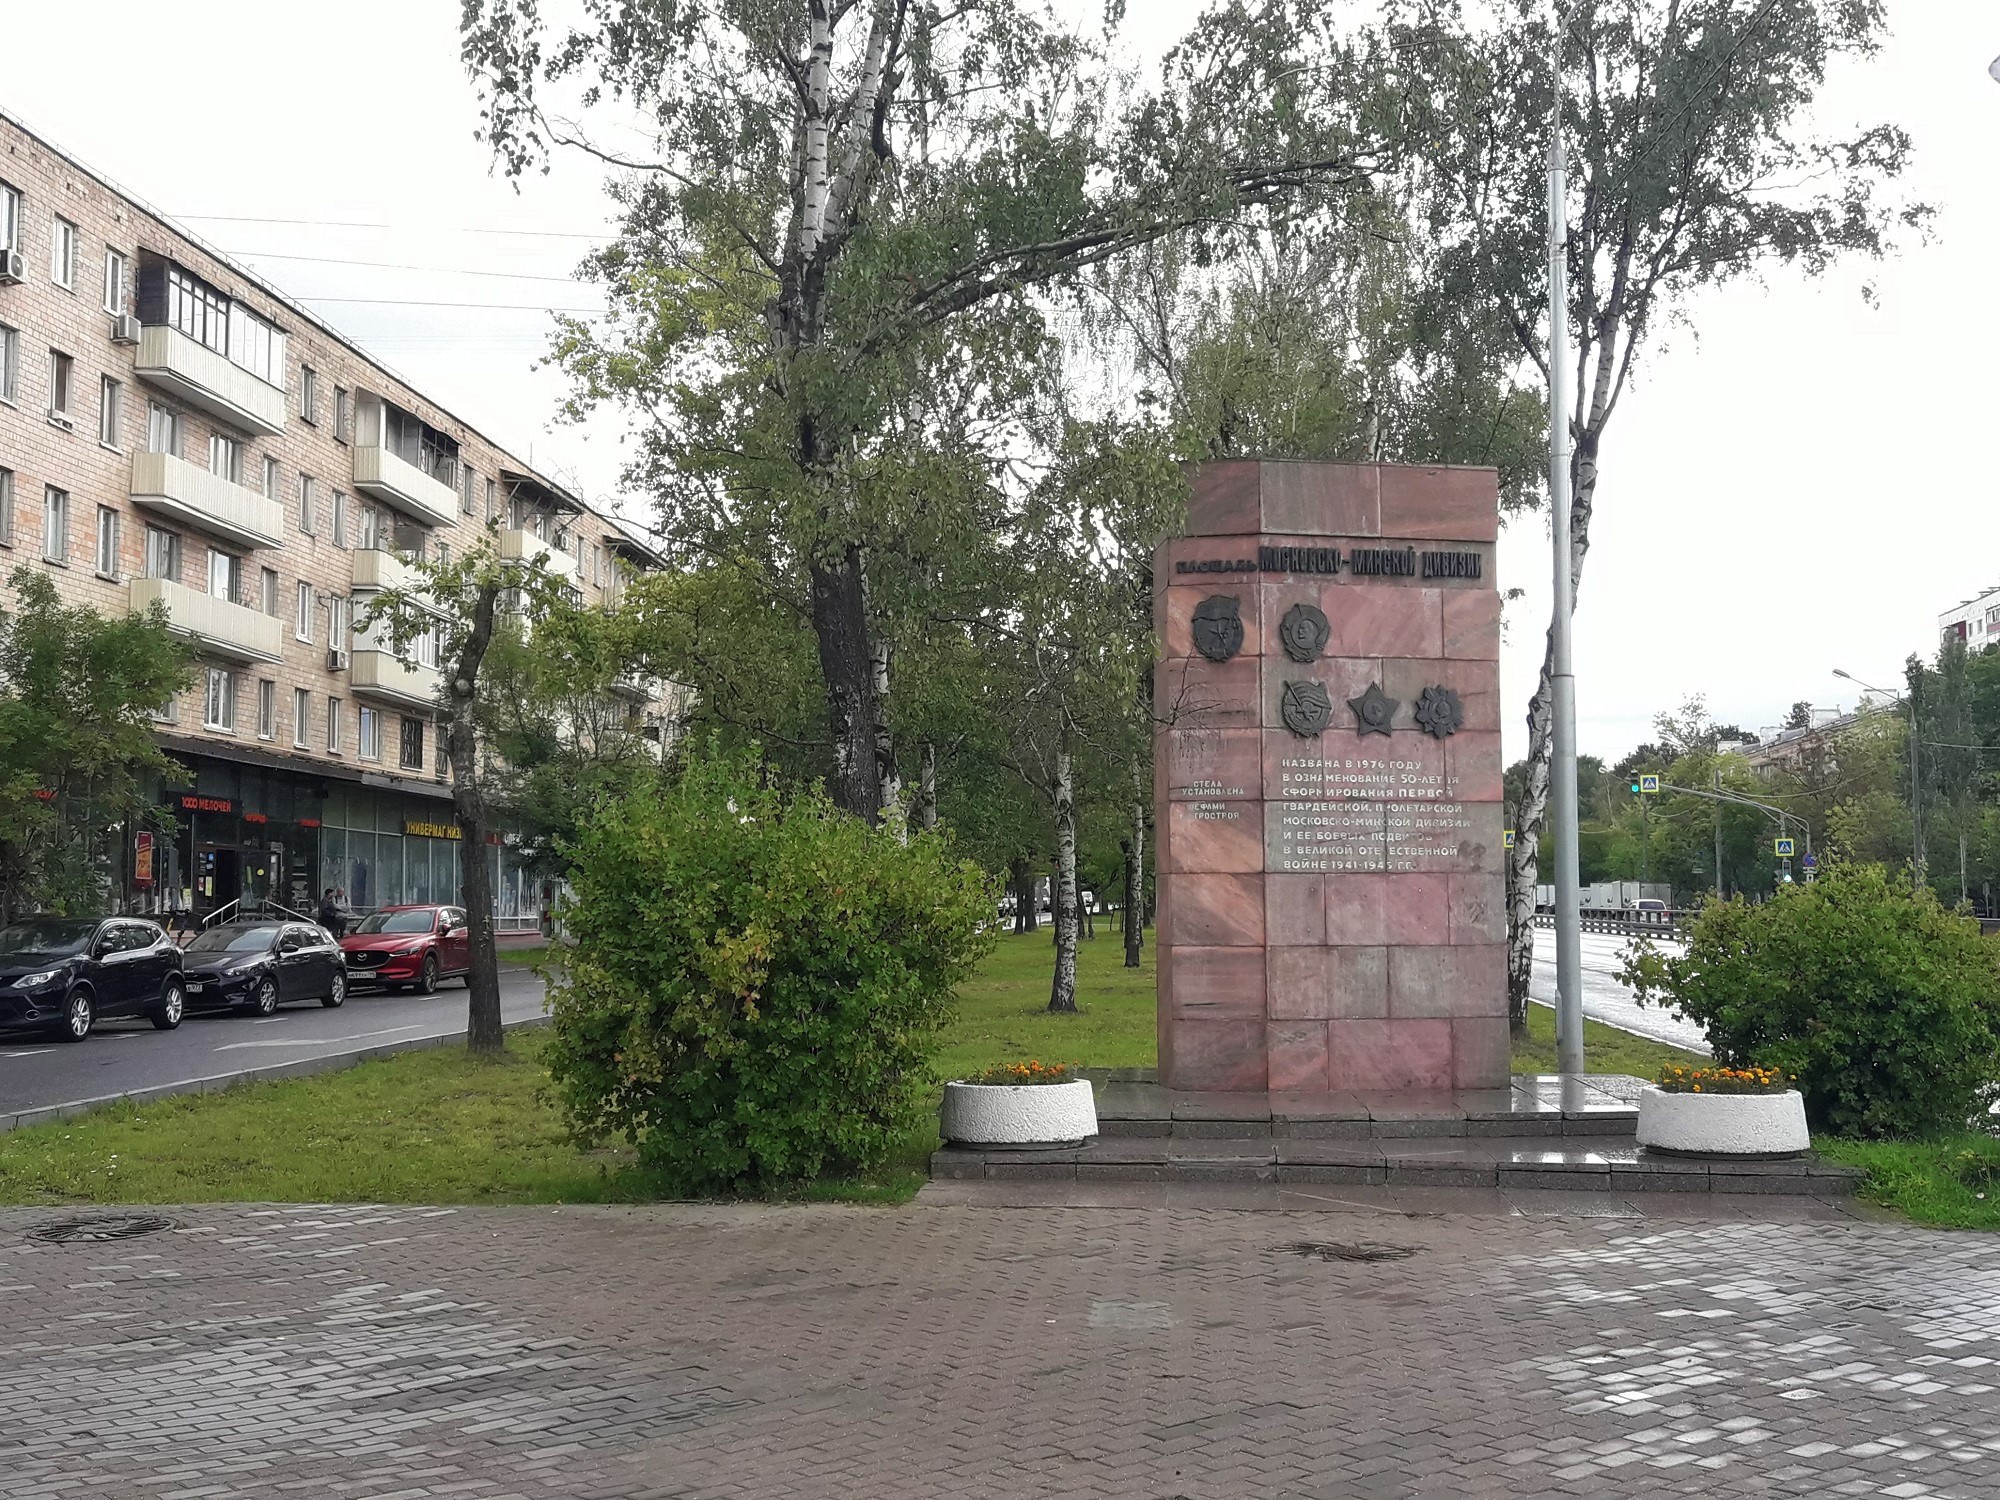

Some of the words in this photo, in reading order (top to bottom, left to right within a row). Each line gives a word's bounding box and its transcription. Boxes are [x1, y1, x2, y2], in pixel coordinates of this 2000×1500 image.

[1422, 551, 1482, 578] ДИВИЗИИ
[1282, 759, 1340, 768] НАЗВАНА
[1345, 760, 1352, 768] В
[1357, 760, 1385, 769] 1976
[1389, 760, 1422, 770] ГОДУ
[1282, 773, 1290, 782] В
[1193, 780, 1223, 788] СТЕЛА
[1182, 788, 1245, 796] УСТАНОВЛЕНА
[1375, 802, 1463, 813] ПОЛЕТАРСКОЙ
[1283, 831, 1291, 840] И
[1297, 831, 1312, 840] ЕЕ
[1283, 846, 1291, 855] В
[1297, 844, 1353, 855] ВЕЛИКОЙ
[1359, 845, 1459, 856] ОТЕЕСТВЕННОЙ
[1284, 858, 1327, 869] ВОЙНЕ
